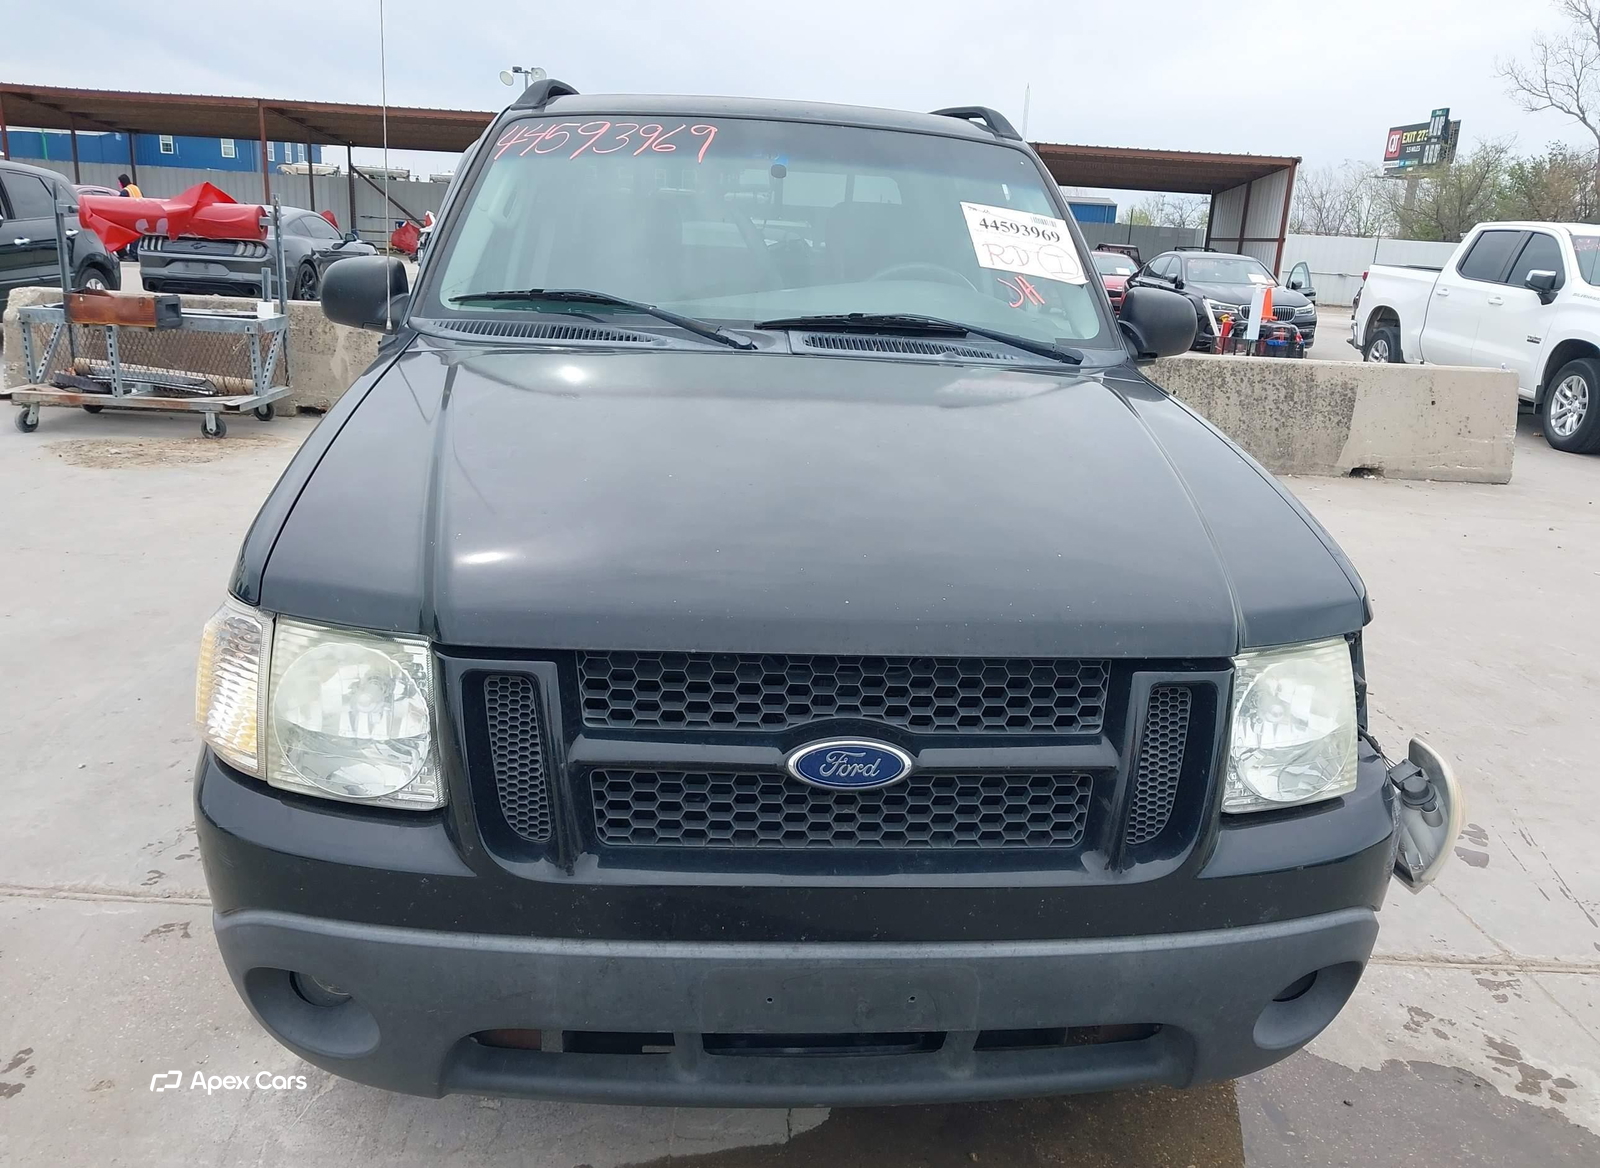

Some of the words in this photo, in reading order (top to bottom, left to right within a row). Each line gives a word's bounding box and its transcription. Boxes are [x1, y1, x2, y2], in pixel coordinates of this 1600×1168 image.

[494, 121, 718, 163] 44593969
[1388, 134, 1400, 153] QT
[1402, 131, 1417, 144] EXIT
[979, 217, 1061, 243] 44593969
[819, 750, 882, 777] Ford
